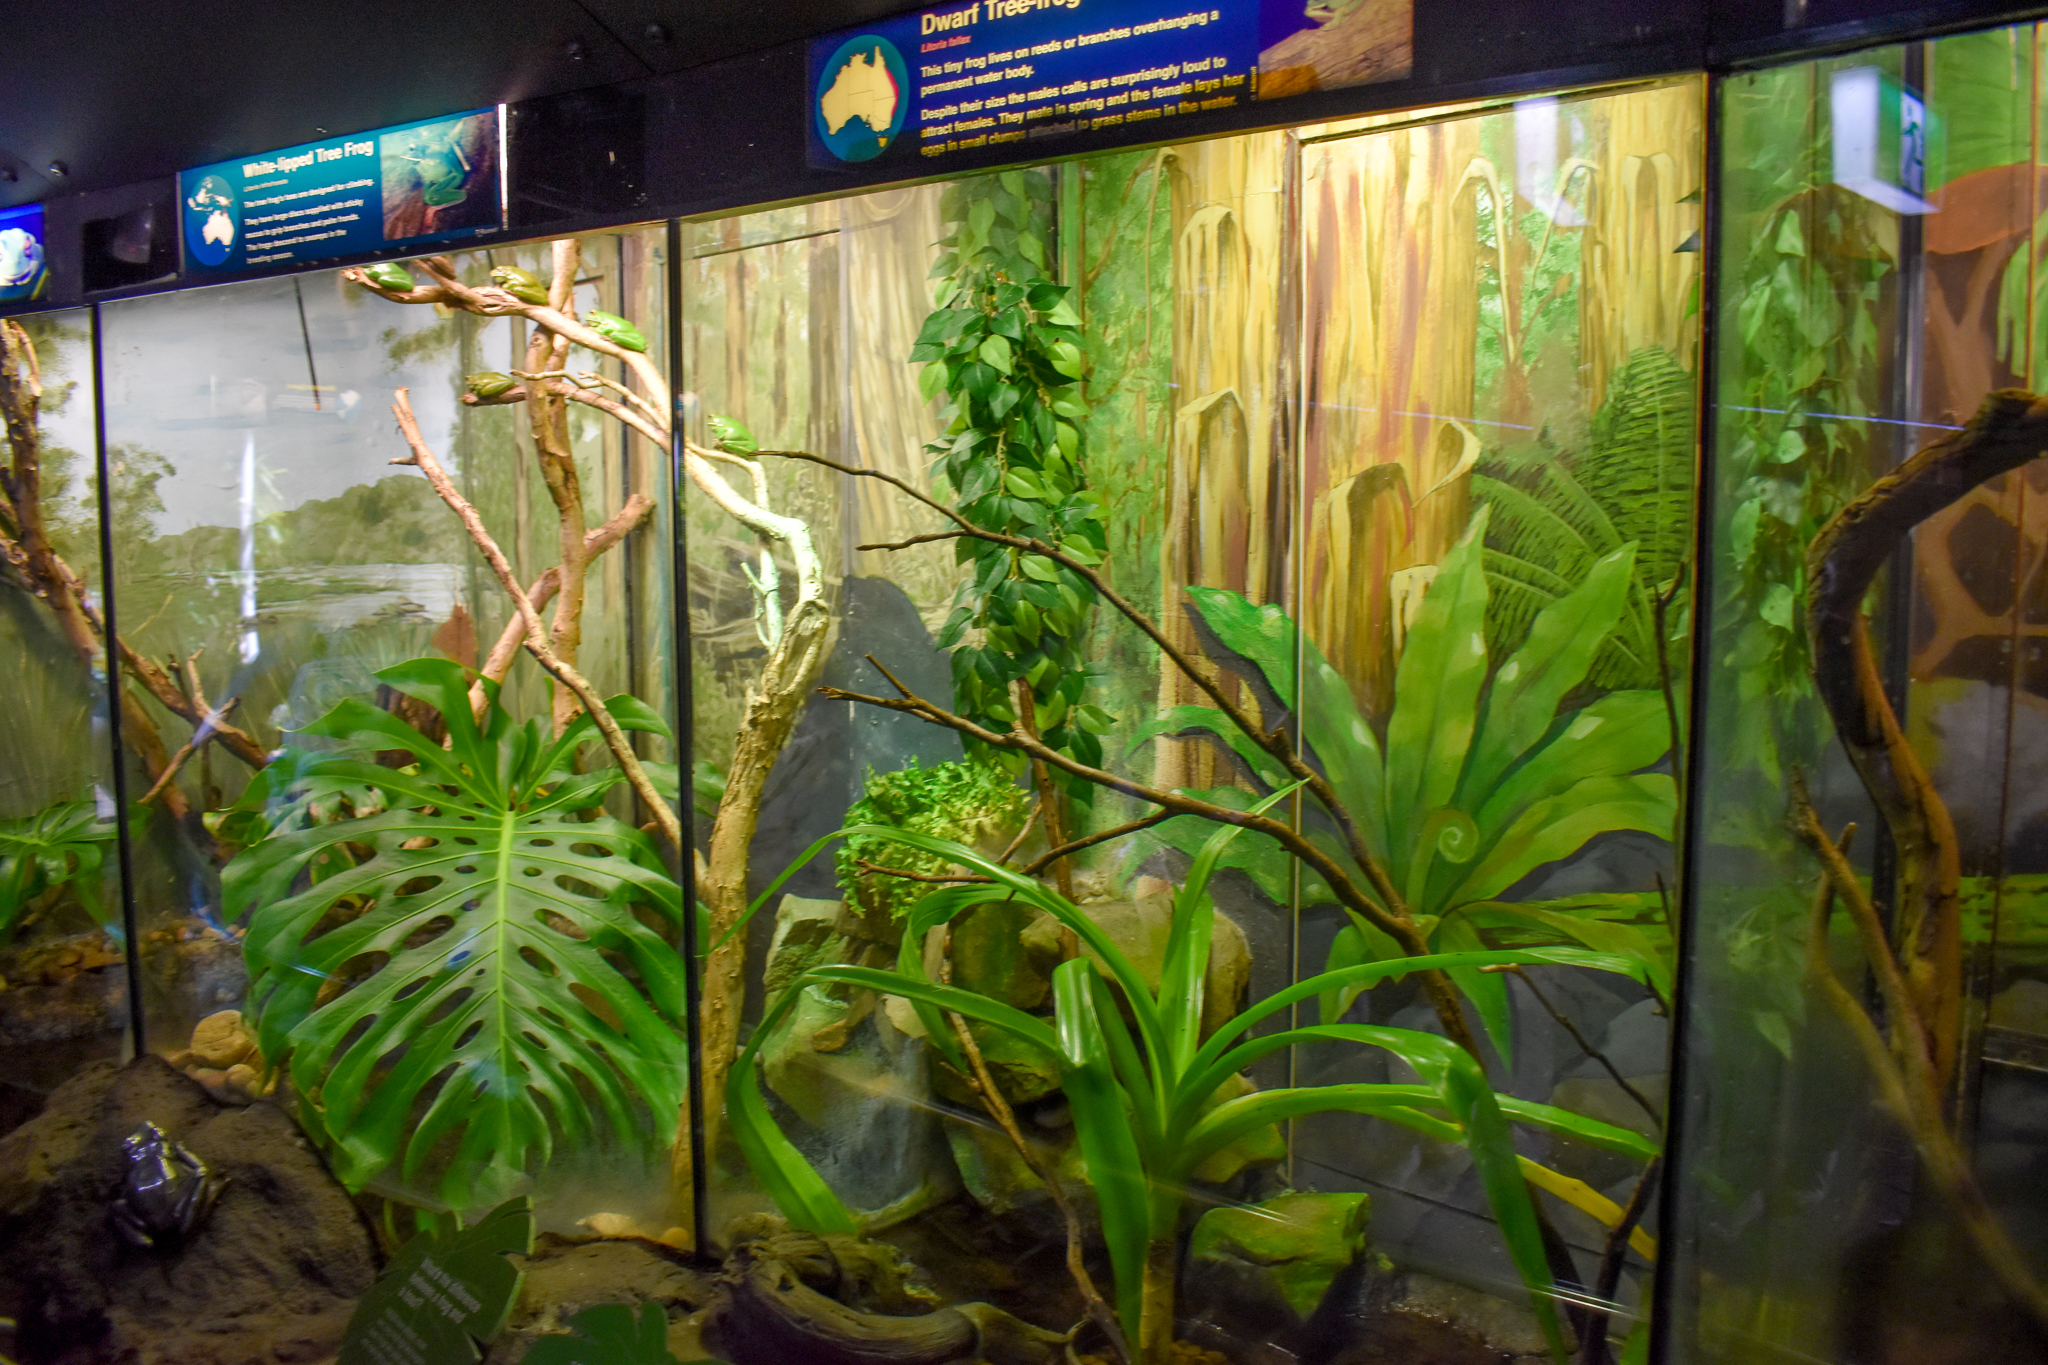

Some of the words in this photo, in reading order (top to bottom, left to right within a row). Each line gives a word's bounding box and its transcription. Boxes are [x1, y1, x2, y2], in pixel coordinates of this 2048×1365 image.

[920, 64, 942, 77] This
[944, 61, 963, 73] tiny
[965, 56, 987, 69] frog
[988, 51, 1013, 64] lives
[1014, 47, 1030, 59] on
[1031, 40, 1062, 55] reeds
[1063, 38, 1076, 49] or
[1078, 25, 1131, 47] branches
[1133, 11, 1208, 36] overhanging
[1210, 10, 1220, 21] a
[921, 3, 980, 35] Dwarf
[921, 40, 947, 53] Litoria
[948, 35, 971, 47] fallax
[920, 75, 974, 98] permanent
[975, 70, 1004, 85] water
[1005, 64, 1035, 79] body.
[921, 105, 959, 120] Despite
[960, 100, 984, 113] their
[985, 96, 1007, 109] size
[1008, 92, 1025, 104] the
[1027, 86, 1060, 101] males
[1061, 81, 1088, 95] calls
[1090, 77, 1109, 90] are
[1110, 64, 1181, 87] surprisingly
[1183, 57, 1211, 74] loud
[1212, 56, 1228, 69] to
[921, 123, 953, 138] attract
[954, 117, 997, 132] females.
[998, 111, 1025, 124] They
[1026, 106, 1053, 119] mate
[1055, 103, 1066, 115] in
[1068, 96, 1105, 114] spring
[1106, 92, 1129, 106] and
[1130, 89, 1150, 101] the
[1152, 81, 1194, 99] female
[1194, 77, 1221, 94] lays
[1223, 74, 1246, 87] her
[921, 143, 946, 156] eggs
[947, 140, 958, 151] in
[959, 134, 987, 149] small
[1077, 117, 1090, 130] to
[1091, 113, 1124, 130] grass
[1125, 106, 1162, 123] stems
[1164, 104, 1176, 116] in
[1178, 100, 1199, 114] the
[1200, 95, 1237, 110] water.
[242, 150, 314, 178] White-lipped
[315, 147, 343, 163] Tree
[344, 141, 374, 157] Frog
